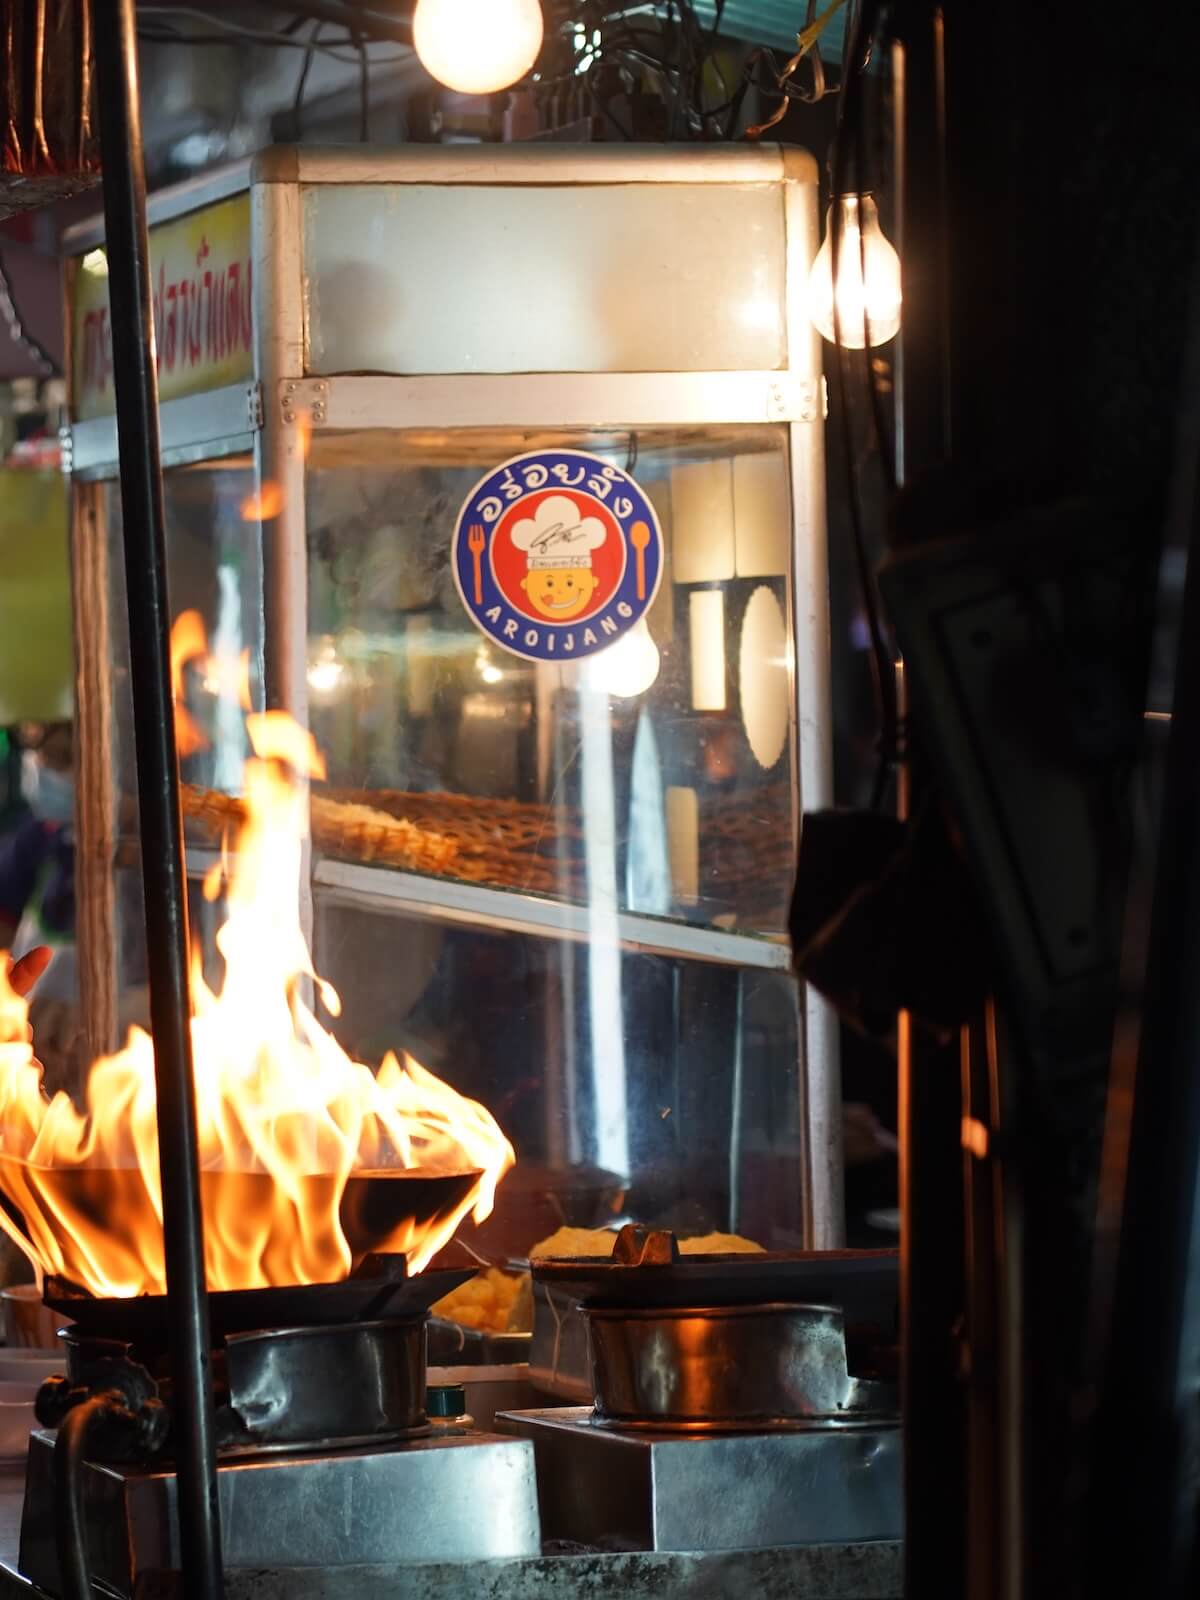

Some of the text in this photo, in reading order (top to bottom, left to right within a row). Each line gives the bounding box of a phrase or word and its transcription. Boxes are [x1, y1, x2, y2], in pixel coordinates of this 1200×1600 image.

[476, 463, 633, 523] อร่อยจัง
[485, 600, 633, 652] AROIJANG
